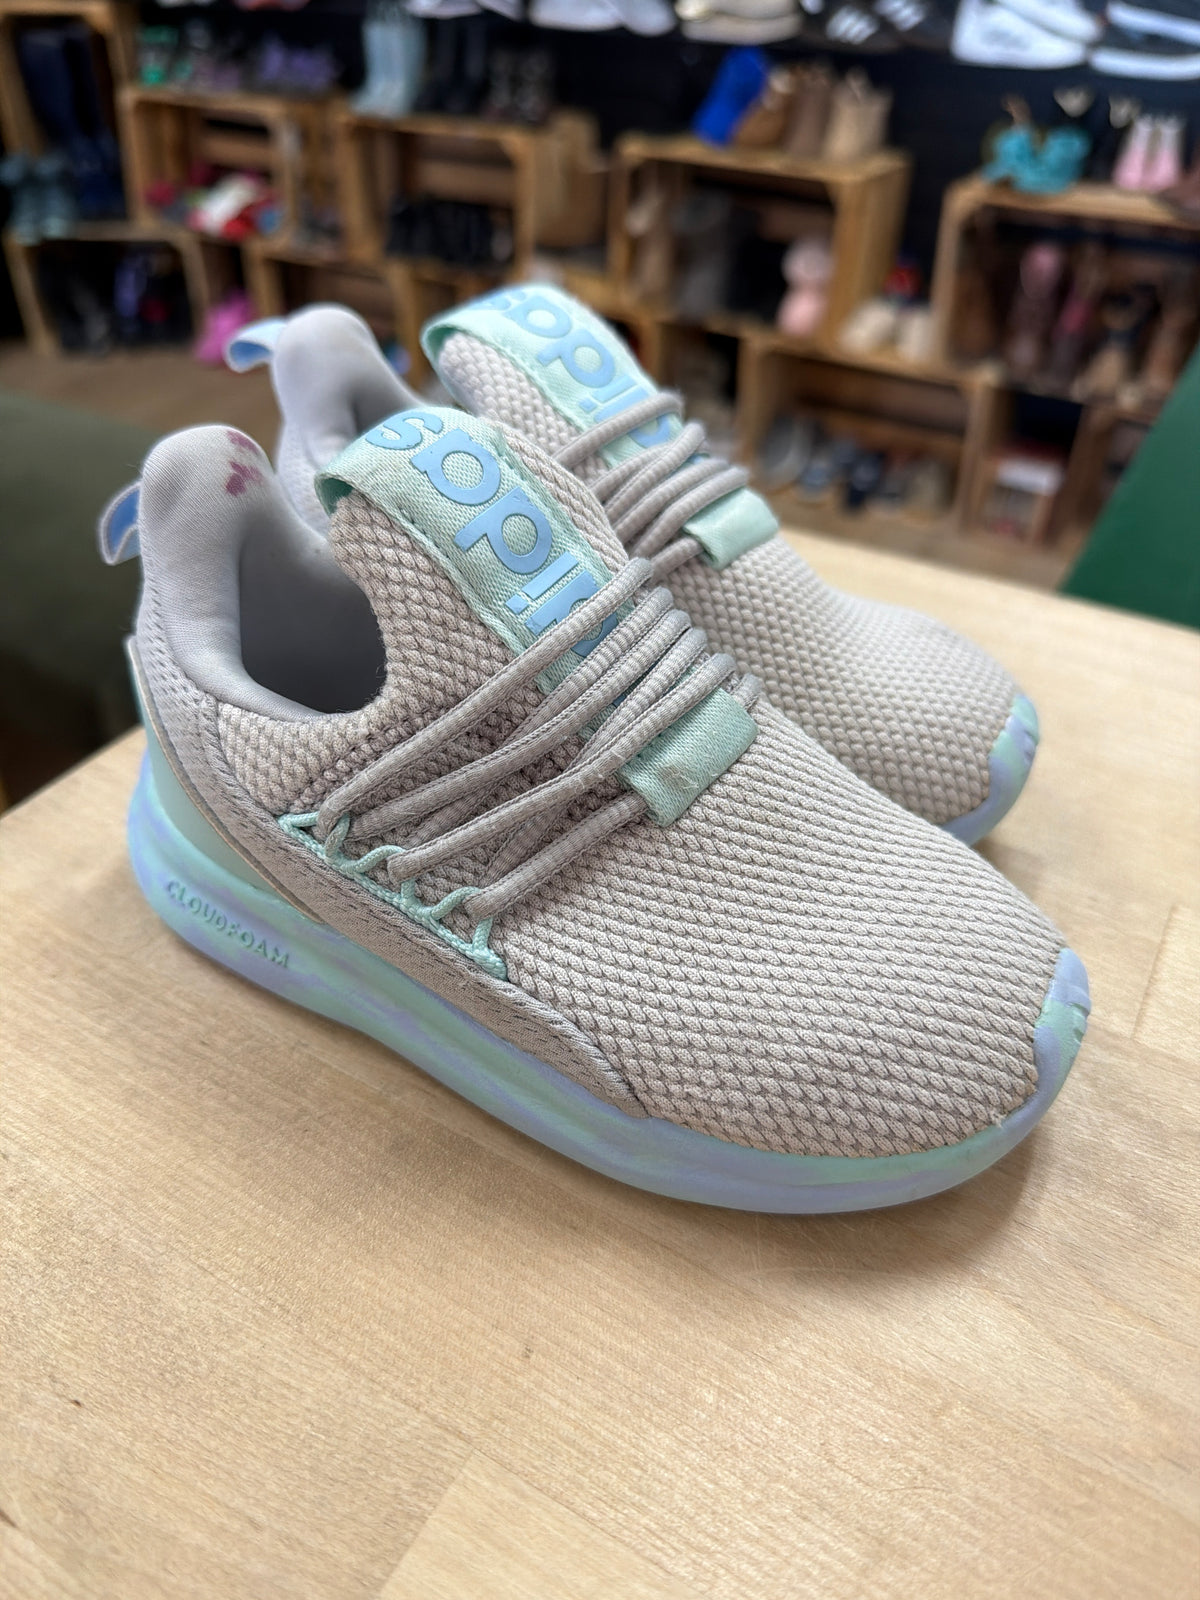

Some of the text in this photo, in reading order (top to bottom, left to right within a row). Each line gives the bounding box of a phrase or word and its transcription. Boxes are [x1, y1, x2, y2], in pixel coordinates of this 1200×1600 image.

[467, 287, 682, 458] dida
[364, 411, 650, 694] didas
[166, 880, 290, 969] CLOUDFOAM
